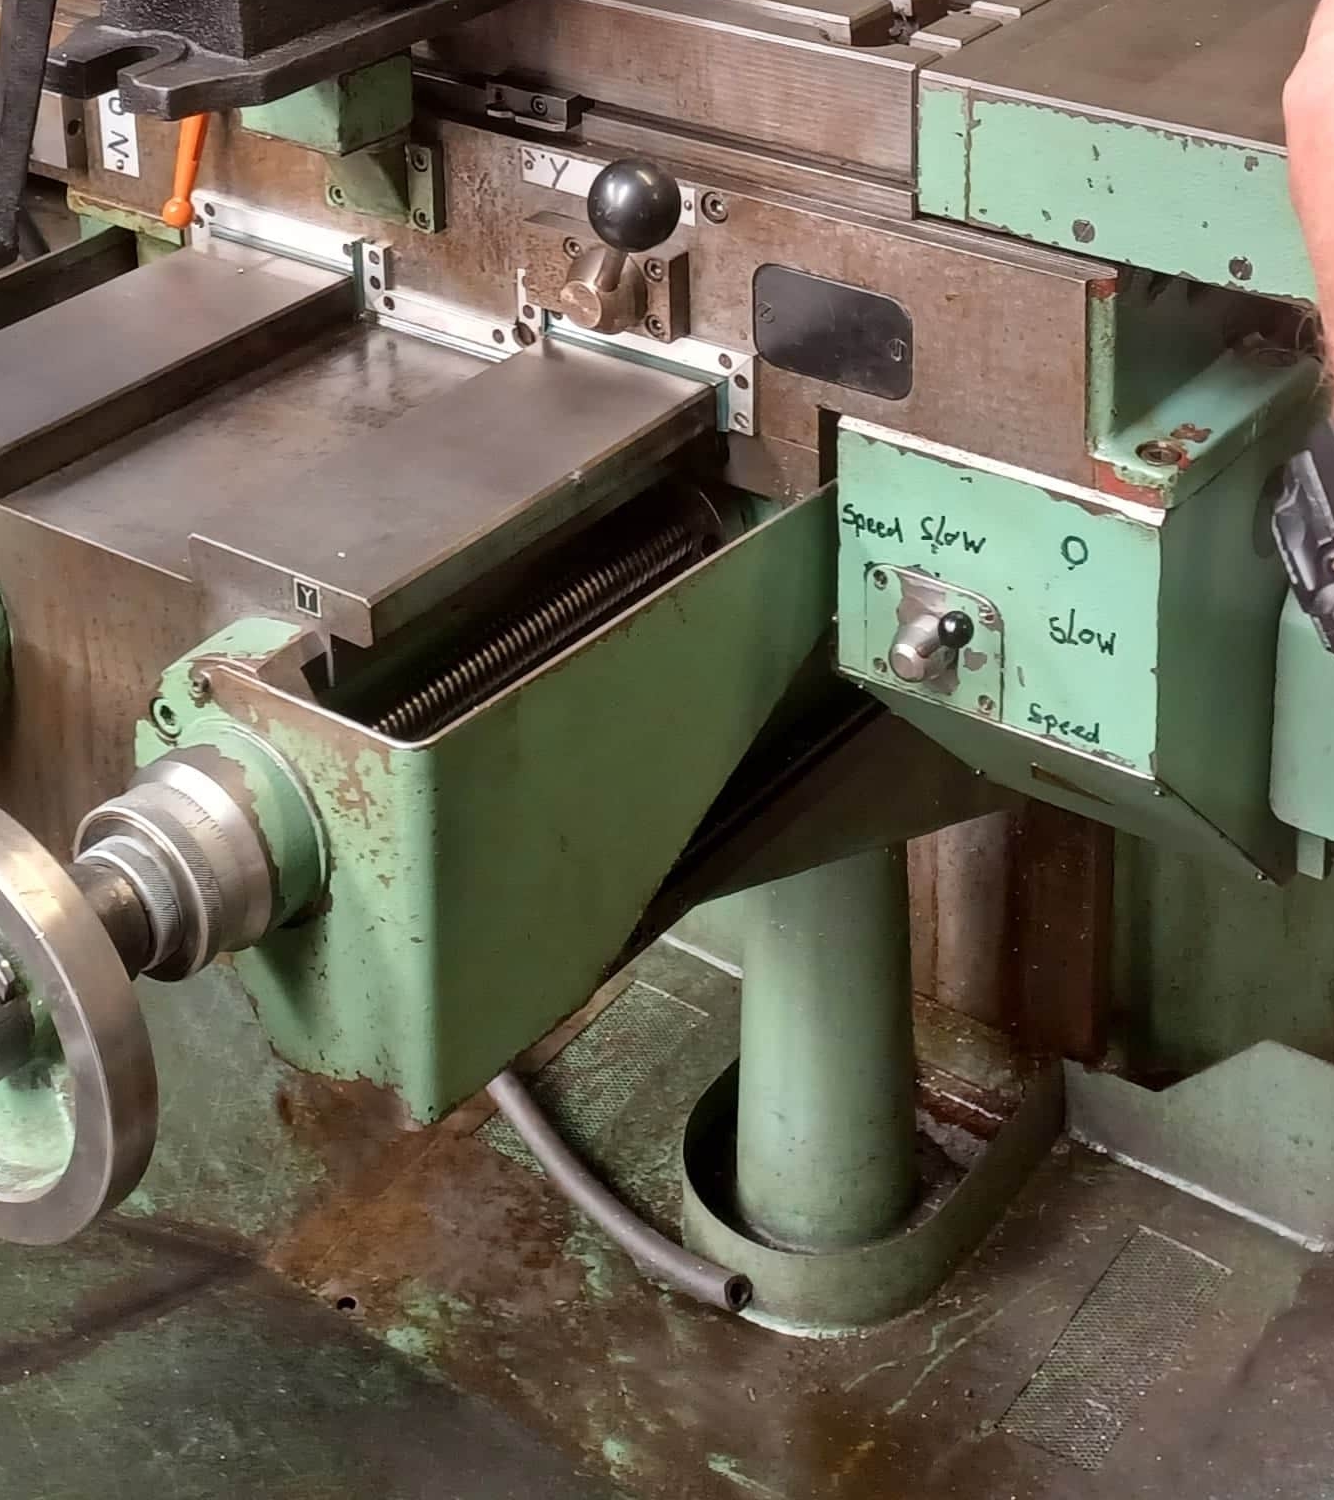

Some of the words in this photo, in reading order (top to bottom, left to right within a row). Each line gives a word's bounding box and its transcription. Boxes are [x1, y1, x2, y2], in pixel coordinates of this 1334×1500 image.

[842, 503, 904, 543] Speed
[300, 585, 314, 608] Y
[1027, 703, 1100, 744] Speed
